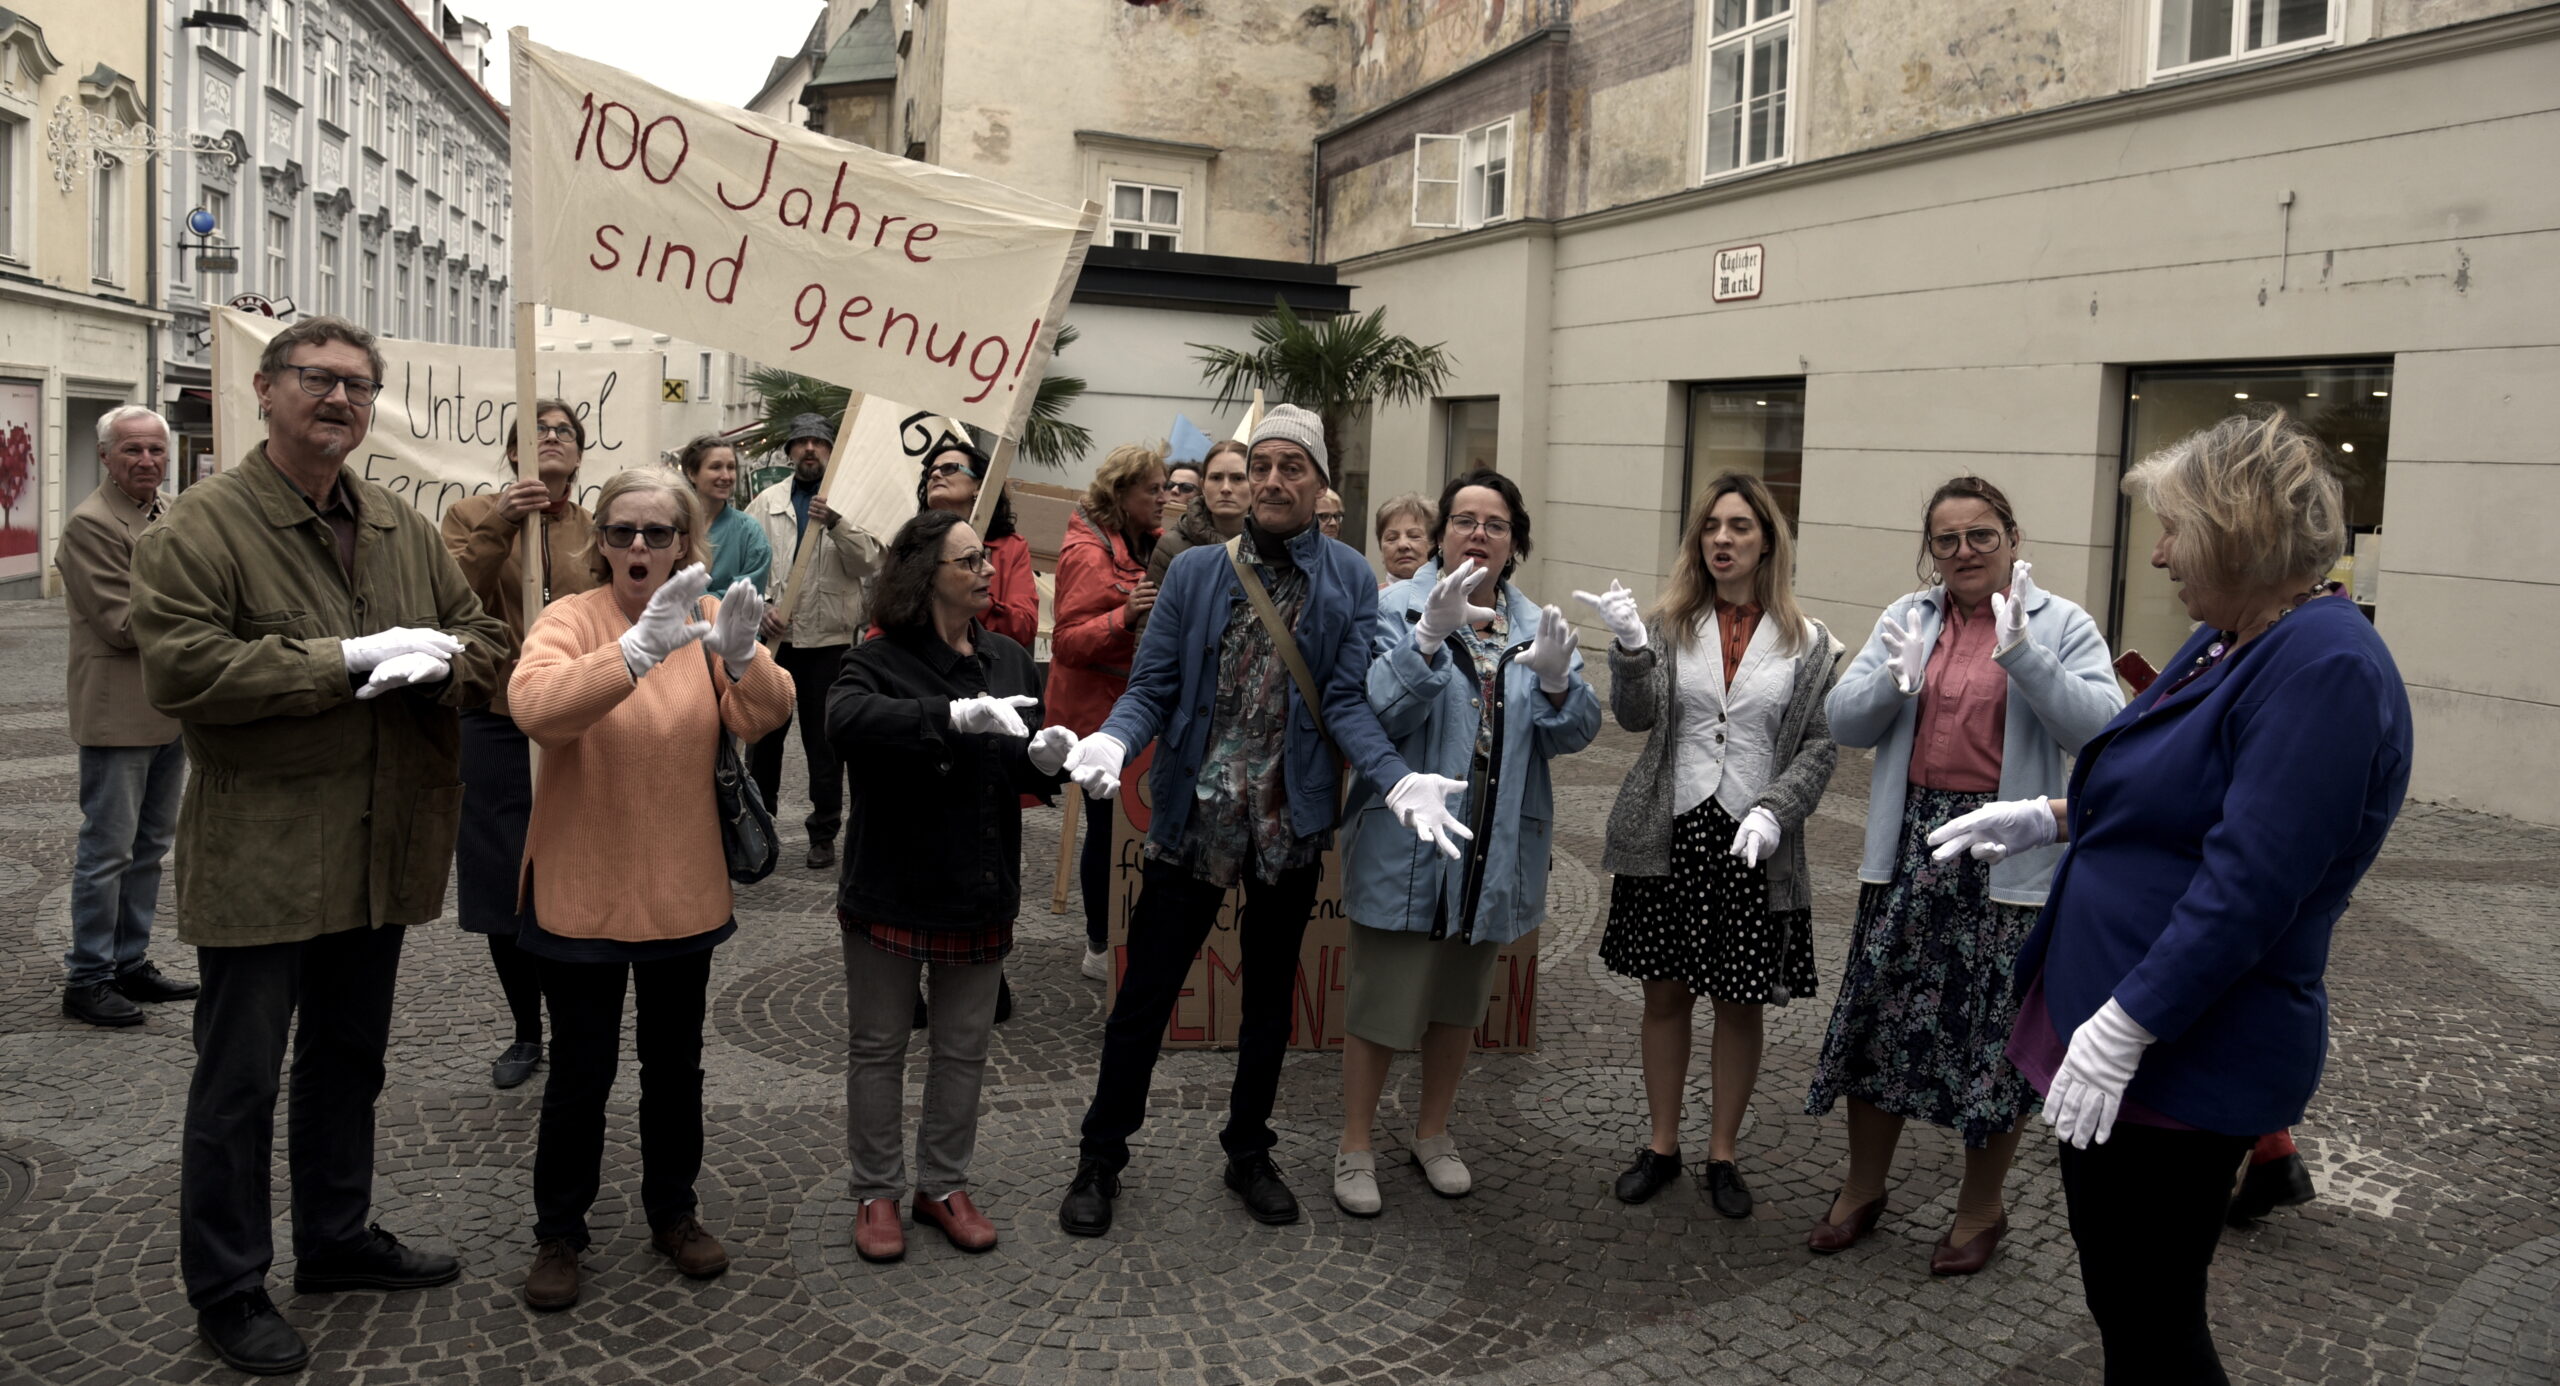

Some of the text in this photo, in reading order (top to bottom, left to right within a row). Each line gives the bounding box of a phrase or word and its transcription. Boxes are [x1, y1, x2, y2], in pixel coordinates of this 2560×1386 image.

[575, 92, 938, 263] 100 Jahre
[231, 296, 265, 310] BAK
[590, 224, 1041, 403] sind genug!
